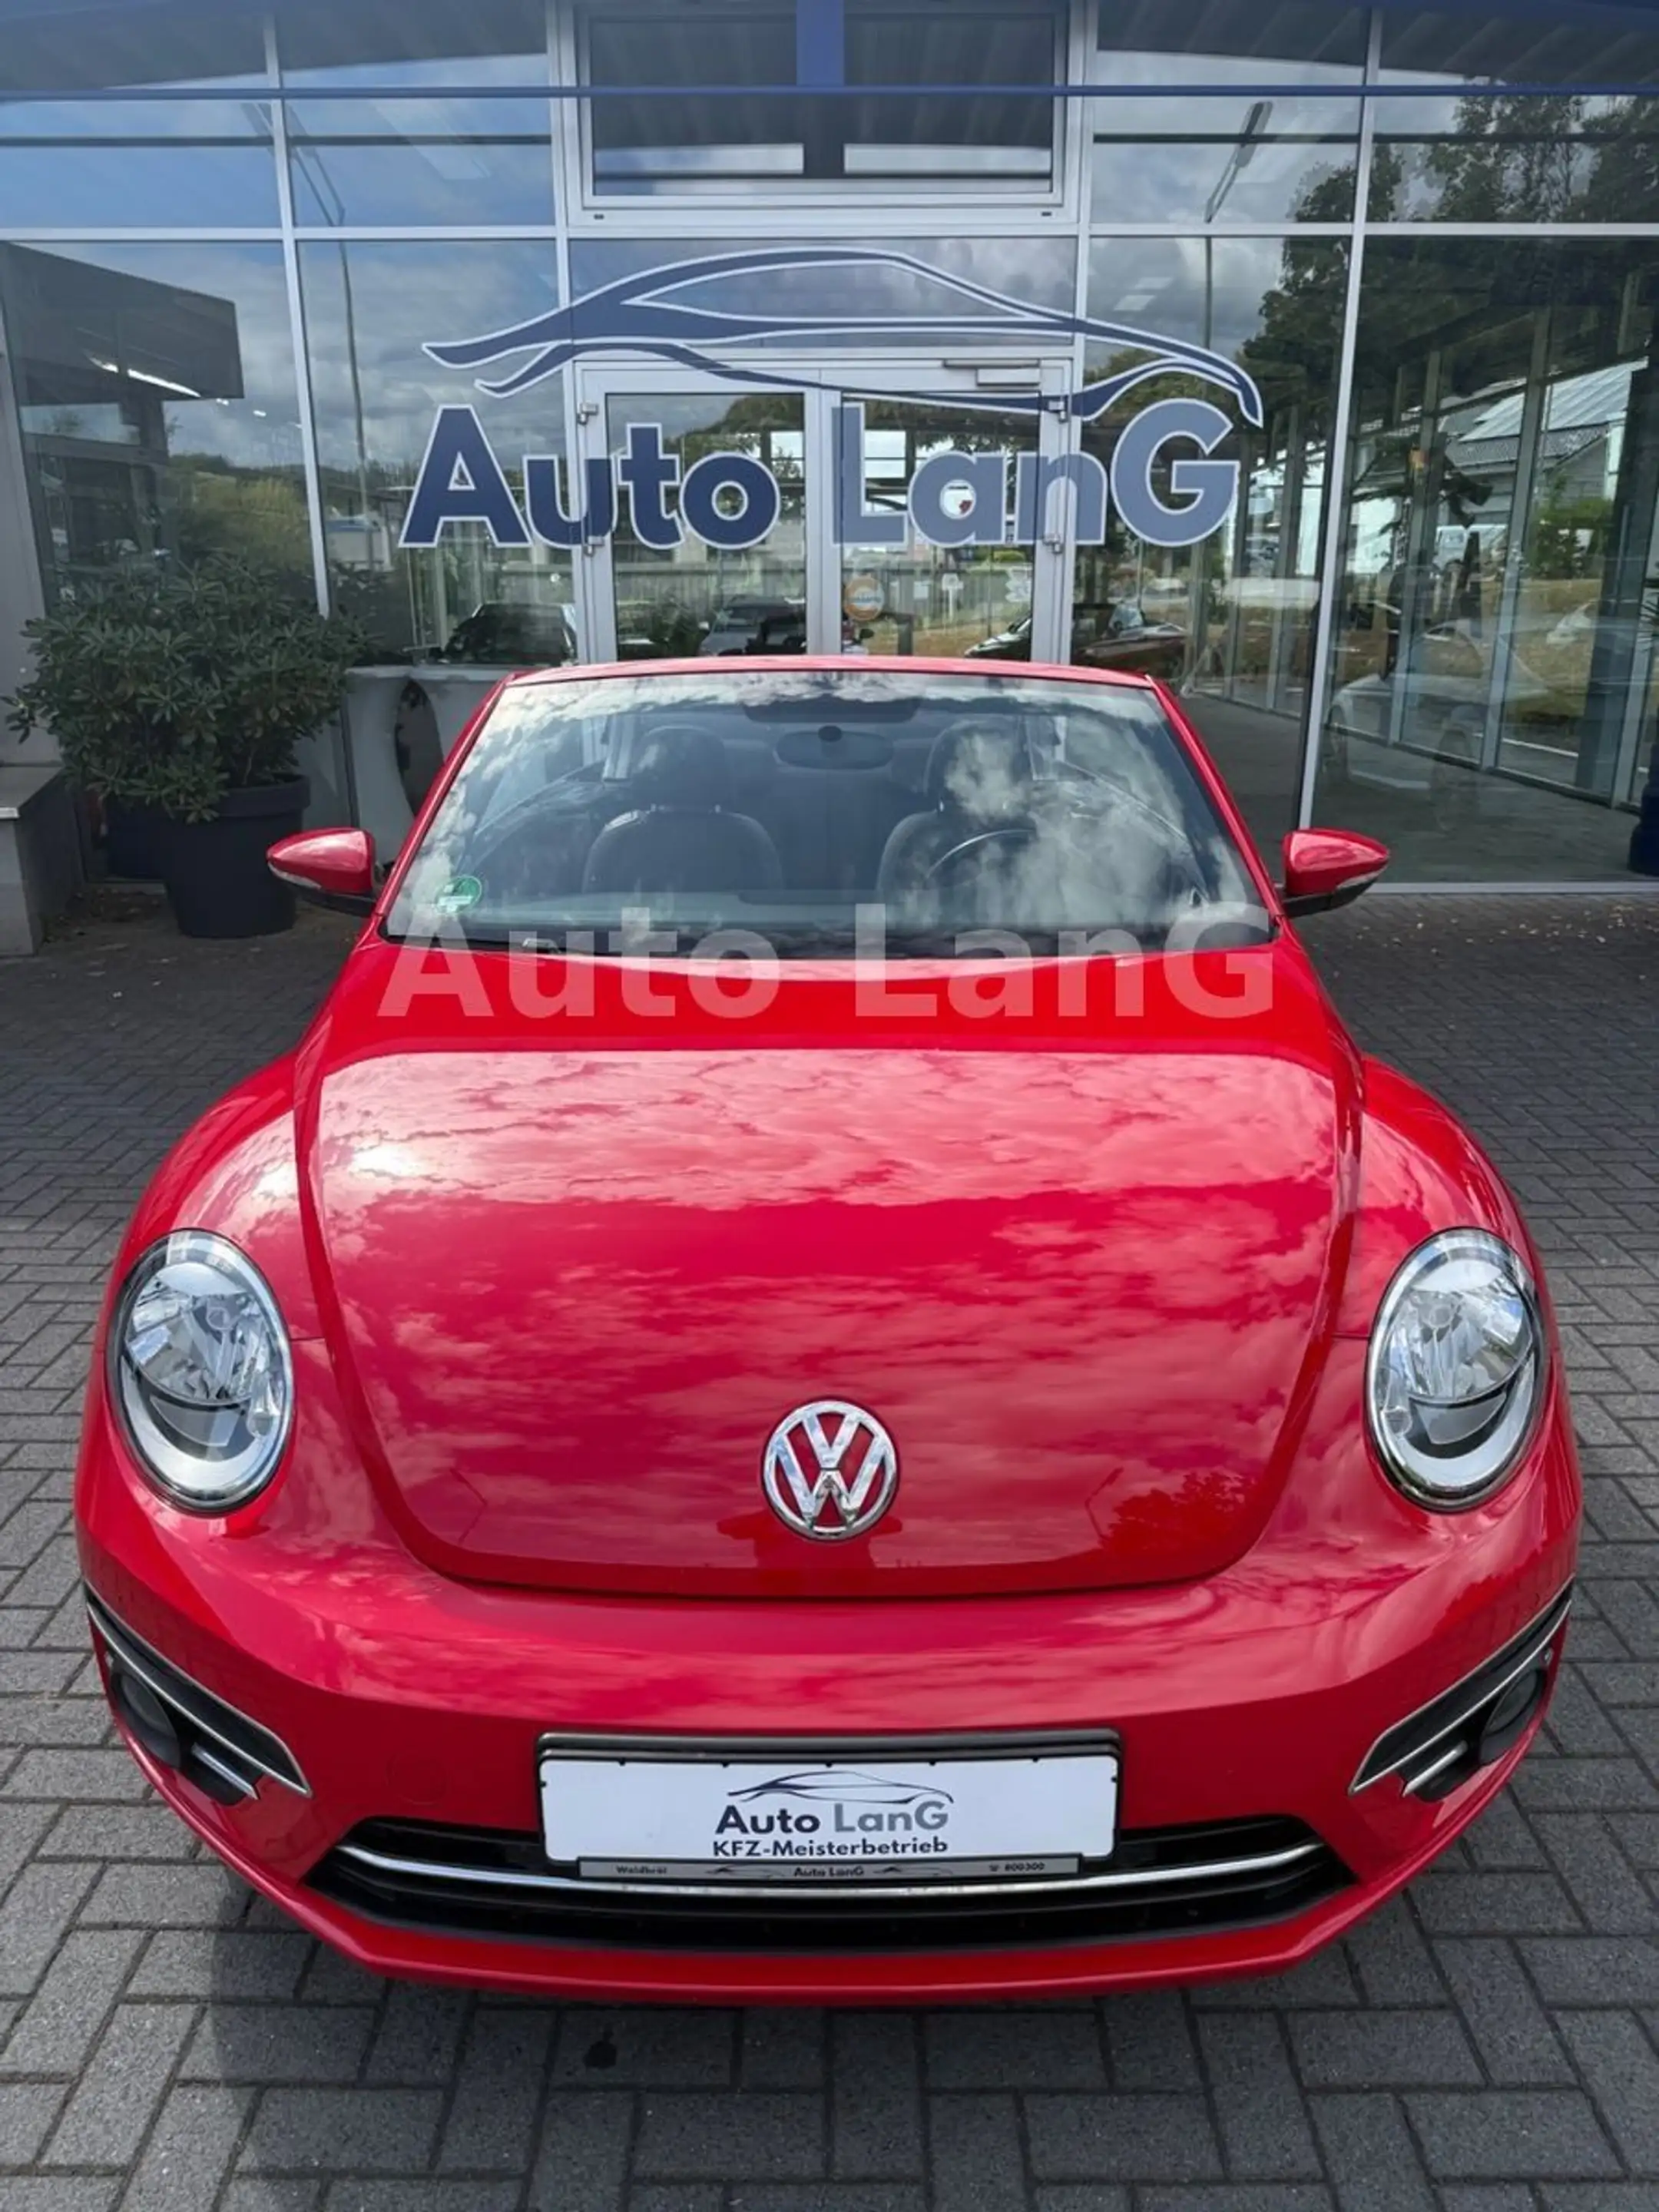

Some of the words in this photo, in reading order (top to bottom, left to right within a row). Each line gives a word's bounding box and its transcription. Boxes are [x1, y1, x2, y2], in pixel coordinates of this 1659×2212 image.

[399, 403, 780, 550] Auto
[832, 398, 1240, 548] LanG
[714, 1805, 821, 1835] Auto
[833, 1801, 949, 1833] LanG
[713, 1836, 949, 1856] KFZ-Meisterbetrieb
[794, 1867, 826, 1876] Auto
